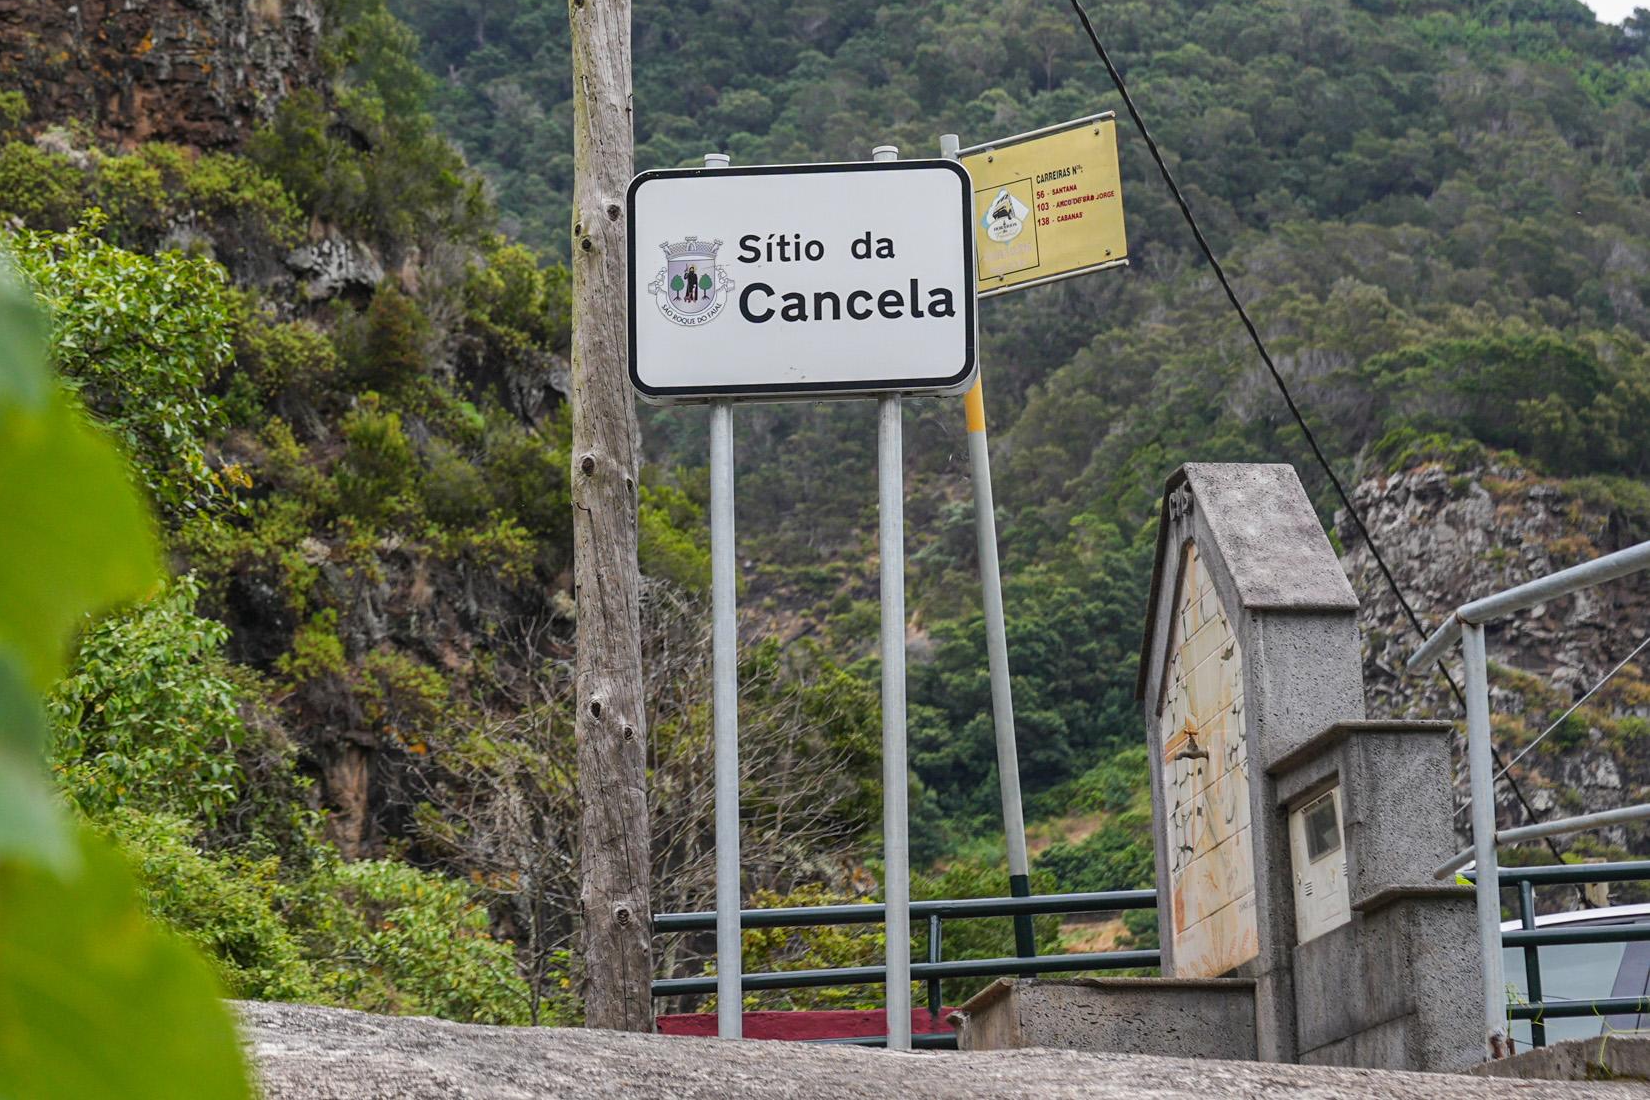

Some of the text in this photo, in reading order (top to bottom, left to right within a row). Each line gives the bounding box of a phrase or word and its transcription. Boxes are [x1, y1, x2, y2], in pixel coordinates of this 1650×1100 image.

[1036, 167, 1071, 184] CARREIRAS
[1036, 190, 1045, 199] 56
[1052, 184, 1077, 195] SANTANA
[1037, 202, 1049, 212] 103
[1096, 190, 1115, 200] JORGE
[1037, 217, 1049, 227] 138
[1056, 212, 1083, 222] CABANAS
[737, 231, 895, 264] Sítio da
[739, 278, 956, 324] Cancela
[672, 314, 695, 325] ROQUE
[697, 315, 708, 324] DO
[707, 302, 723, 318] FAIAL
